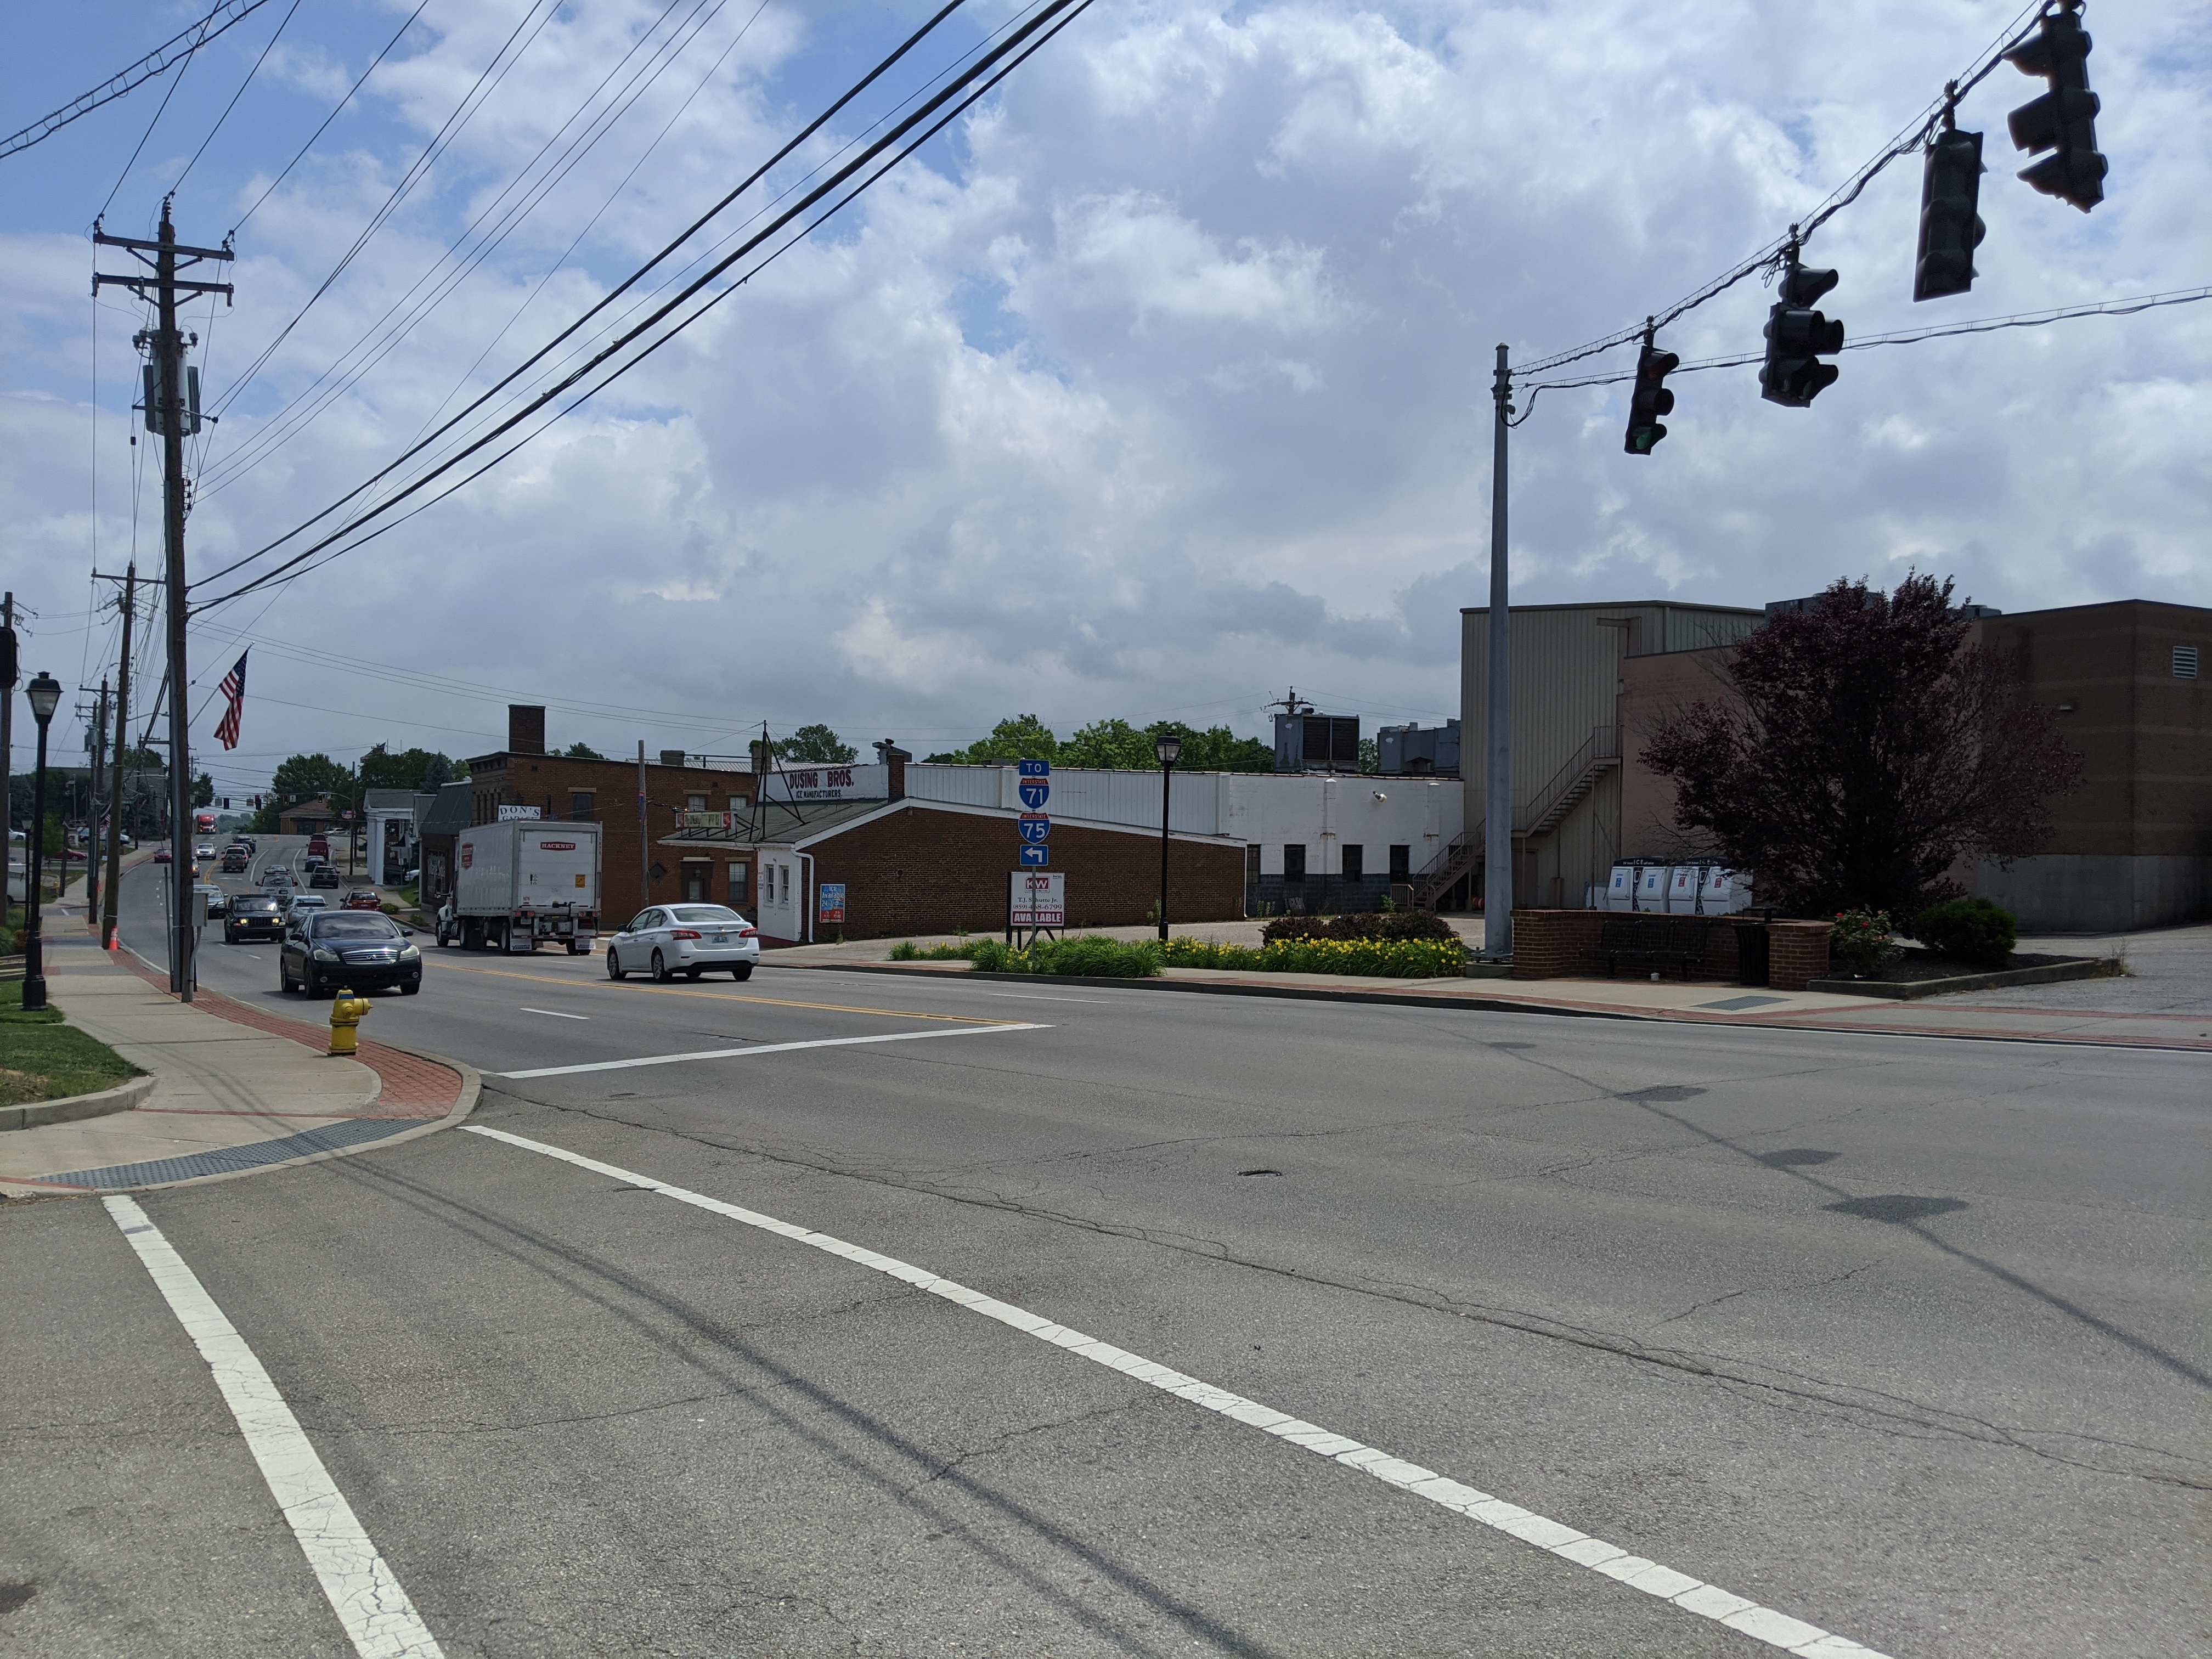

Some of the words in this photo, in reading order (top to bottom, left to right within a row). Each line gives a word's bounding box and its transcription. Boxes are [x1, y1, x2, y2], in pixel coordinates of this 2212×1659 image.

[1026, 763, 1042, 773] TO
[789, 772, 818, 789] DUSING
[827, 769, 854, 787] BROS.
[1026, 788, 1043, 804] 71
[500, 806, 540, 816] DON'S
[1024, 823, 1045, 838] 75
[1026, 879, 1048, 889] KW
[1014, 913, 1061, 922] AVALABLE
